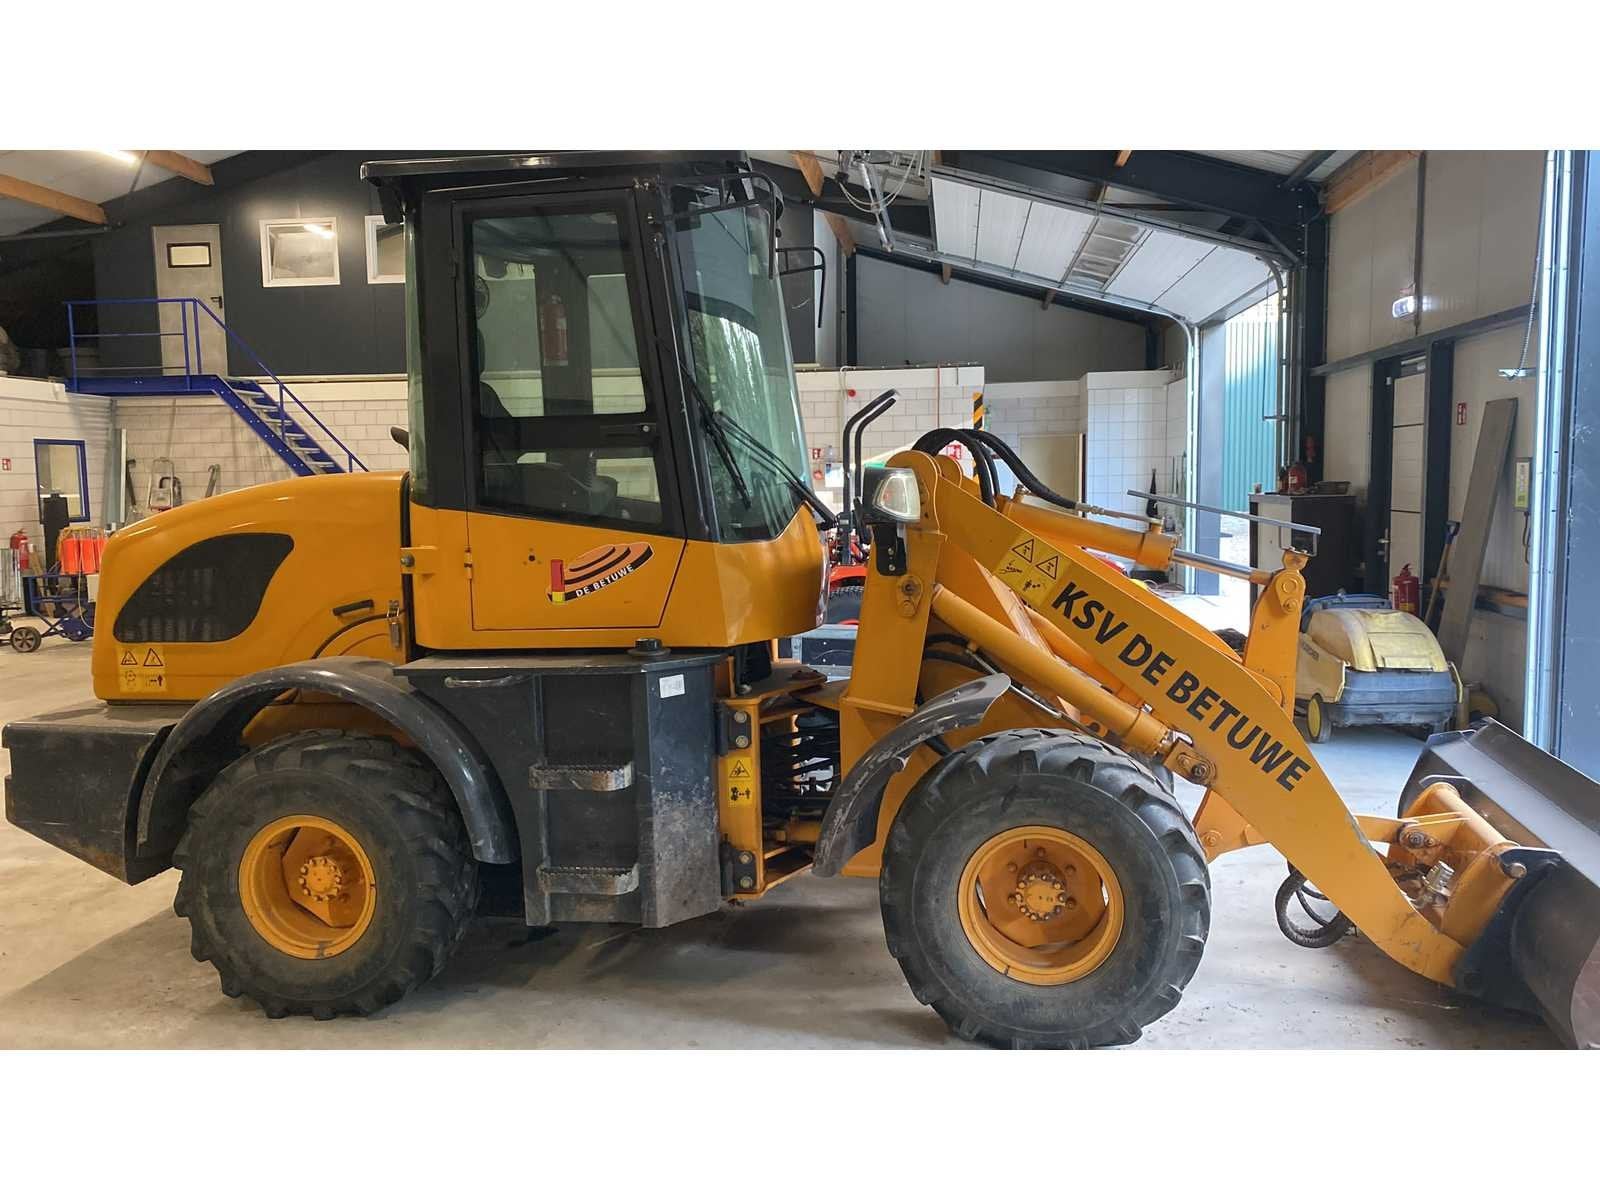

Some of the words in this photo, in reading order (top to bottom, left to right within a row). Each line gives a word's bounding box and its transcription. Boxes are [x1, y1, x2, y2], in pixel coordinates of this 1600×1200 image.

[576, 586, 591, 597] DE
[593, 564, 634, 590] BETUWE
[1051, 581, 1128, 645] KSV
[1118, 633, 1176, 686] DE
[1166, 670, 1311, 792] BETUWE
